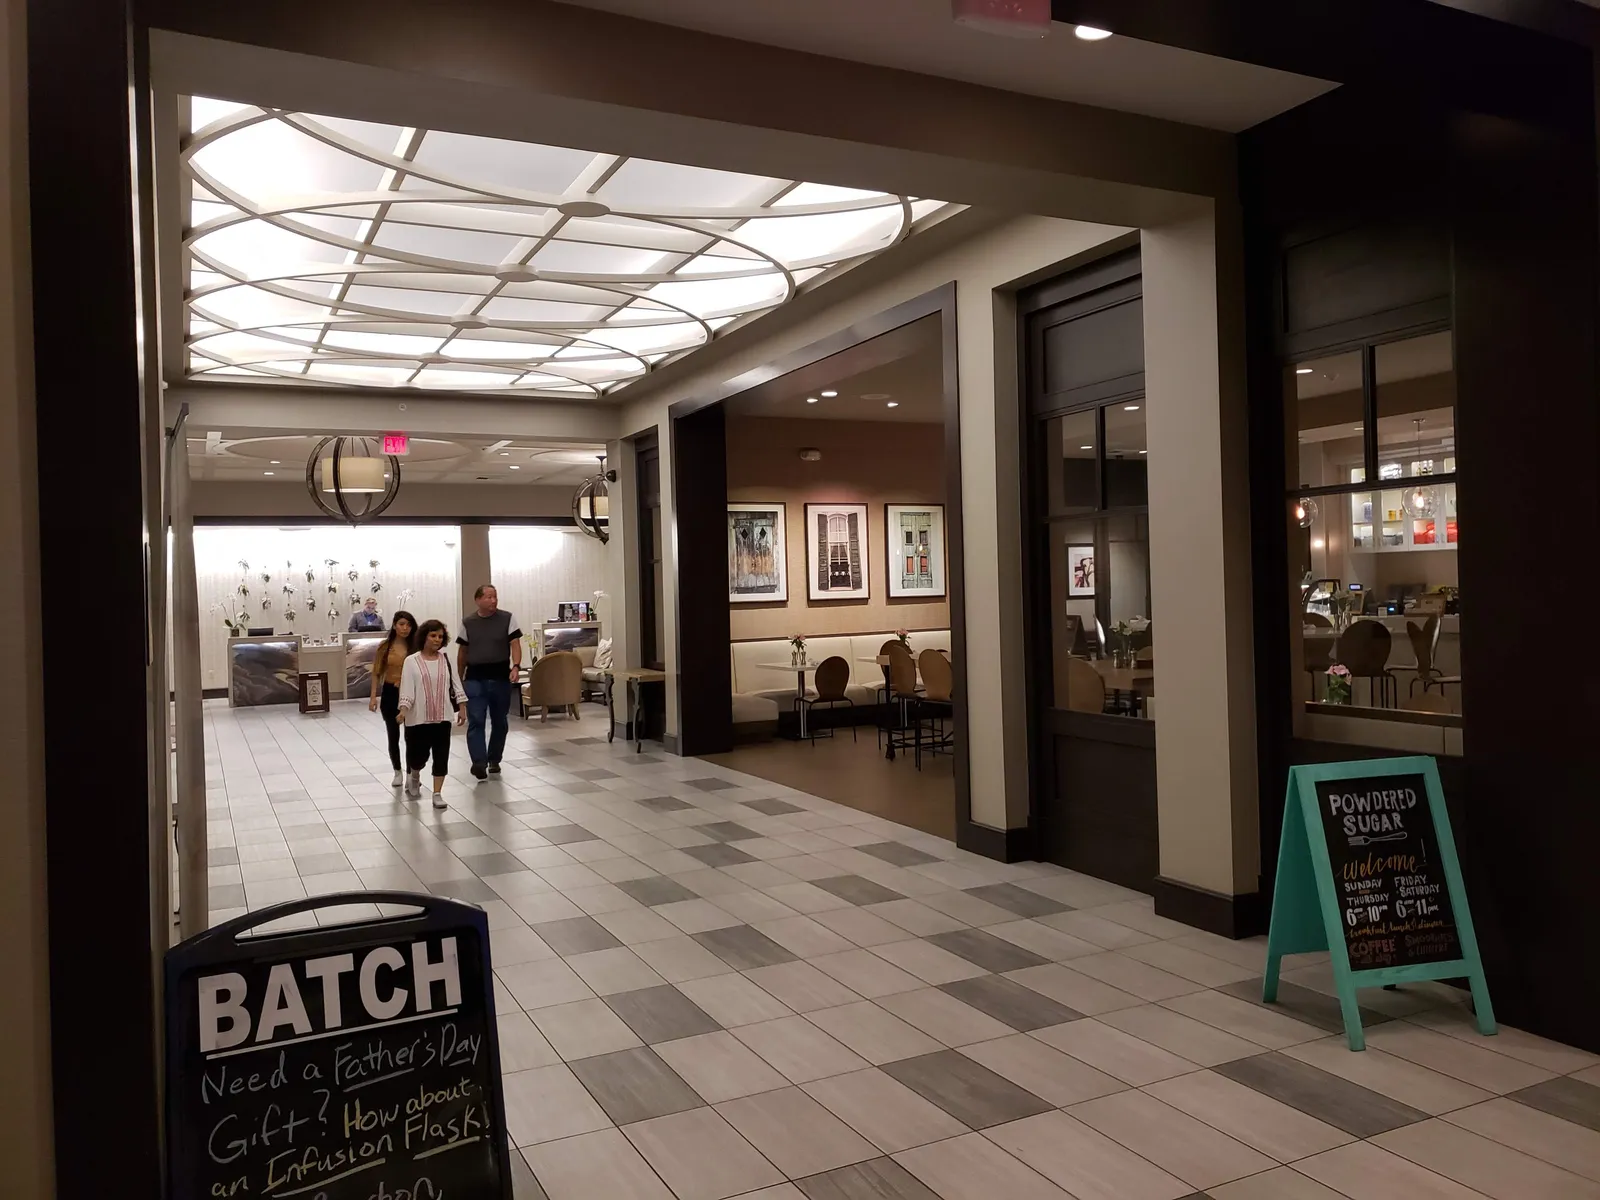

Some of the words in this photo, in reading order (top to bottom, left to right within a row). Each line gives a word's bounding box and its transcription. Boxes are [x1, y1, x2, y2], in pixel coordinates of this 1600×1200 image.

[1329, 788, 1417, 816] POWDERED
[1342, 812, 1405, 836] SUGAR
[1344, 878, 1383, 892] SUNDAY
[1393, 874, 1427, 888] FRIDAY
[1398, 884, 1440, 898] SATURDAY
[1346, 893, 1390, 907] THURSDAY
[1349, 939, 1396, 958] COFFEE
[197, 936, 462, 1053] BATCH
[201, 1050, 286, 1104] Need
[302, 1066, 323, 1080] a
[334, 1030, 436, 1086] Father's
[440, 1022, 481, 1068] Day
[208, 1088, 331, 1164] Gift?
[344, 1098, 400, 1138] How
[406, 1076, 473, 1115] about
[211, 1176, 249, 1198] an
[262, 1131, 393, 1194] Infusion
